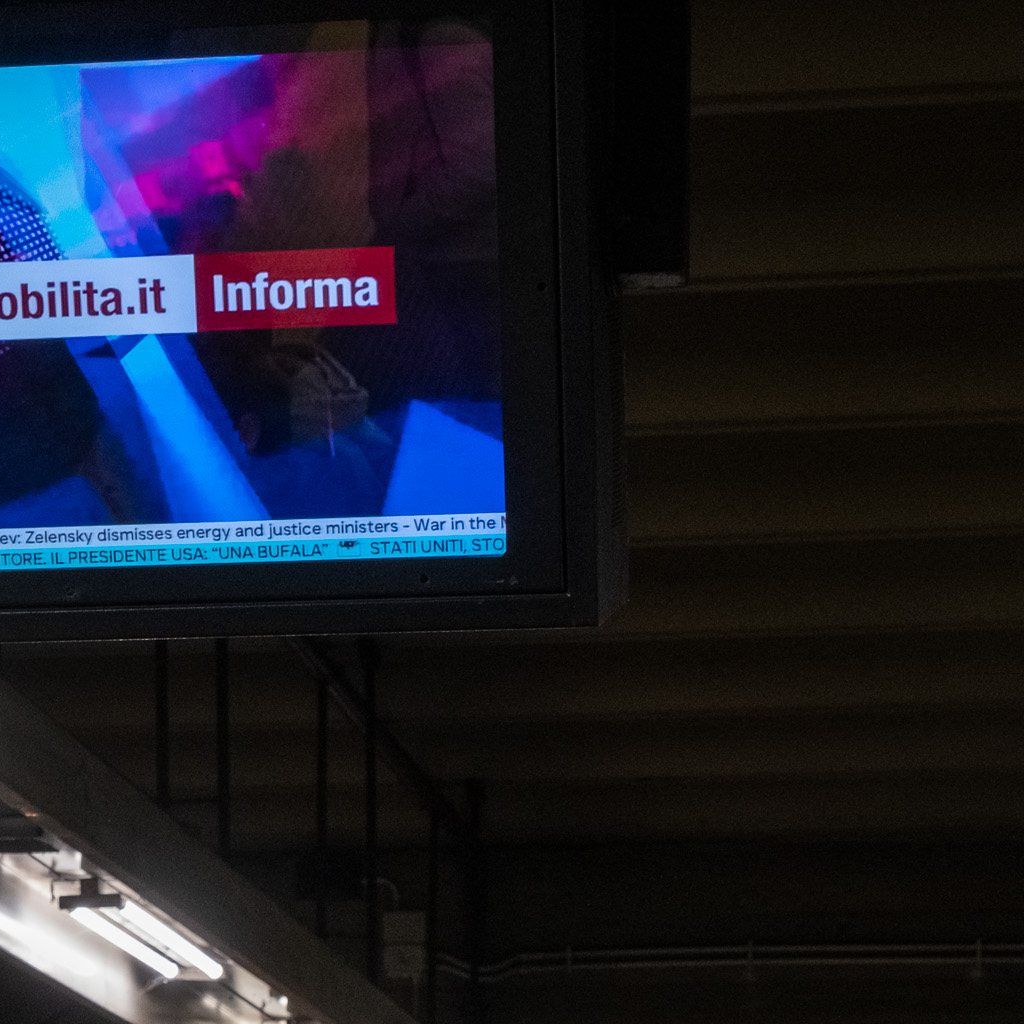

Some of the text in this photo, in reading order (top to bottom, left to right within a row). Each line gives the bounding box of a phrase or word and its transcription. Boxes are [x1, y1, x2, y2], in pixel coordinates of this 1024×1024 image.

[213, 271, 379, 313] Informa
[25, 527, 93, 547] Zelensky
[97, 525, 173, 543] dismisses
[176, 526, 231, 543] energy
[235, 522, 264, 538] and
[267, 520, 322, 540] justice
[326, 519, 399, 535] ministers
[414, 515, 447, 532] War
[451, 515, 465, 530] in
[469, 514, 497, 530] the
[50, 551, 66, 566] IL
[68, 547, 167, 565] PRESIDENTE
[171, 546, 209, 562] USA:
[212, 544, 255, 560] “UNA
[258, 541, 329, 559] BUFALA”
[370, 538, 418, 556] STATI
[420, 536, 468, 555] UNITI,
[471, 536, 505, 552] STO
